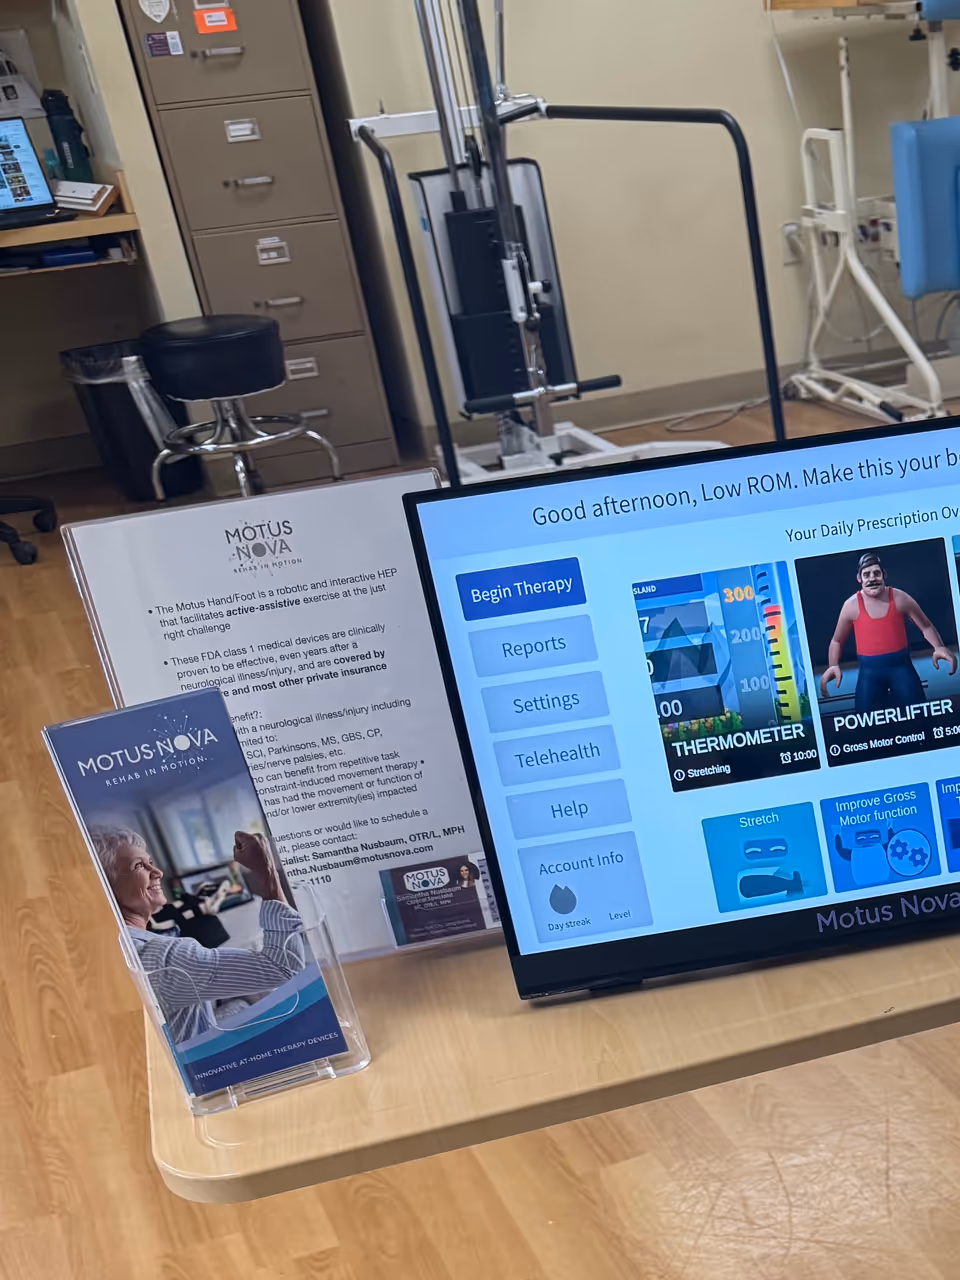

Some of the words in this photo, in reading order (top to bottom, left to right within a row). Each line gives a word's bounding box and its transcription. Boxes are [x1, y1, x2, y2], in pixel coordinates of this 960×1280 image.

[532, 500, 587, 526] Good
[592, 487, 697, 517] afternoon,
[701, 481, 742, 501] Low
[747, 471, 798, 495] ROM.
[803, 463, 854, 487] Make
[857, 457, 894, 480] this
[898, 452, 941, 478] your
[225, 520, 293, 545] MOTUS
[785, 526, 817, 542] Your
[821, 519, 854, 538] Daily
[857, 507, 939, 533] Prescription
[235, 539, 292, 561] NOVA
[233, 565, 258, 574] REHAB
[272, 558, 303, 567] MOTION
[175, 600, 205, 612] Motus
[206, 591, 256, 606] Hand/Foot
[276, 583, 308, 595] robotic
[329, 573, 376, 586] interactive
[376, 567, 397, 579] HEP
[471, 585, 512, 603] Begin
[514, 577, 573, 596] Therapy
[722, 585, 755, 604] 300
[159, 617, 178, 627] that
[179, 610, 224, 624] facilitates
[226, 598, 300, 617] active-assistive
[302, 591, 340, 604] exercise
[369, 583, 386, 595] just
[163, 629, 185, 641] right
[186, 622, 231, 636] challenge
[731, 624, 762, 645] 200
[169, 655, 199, 666] These
[200, 649, 222, 661] FDA
[223, 647, 247, 657] class
[249, 644, 254, 652] 1
[257, 637, 293, 651] medical
[294, 633, 330, 645] devices
[347, 623, 385, 636] clinically
[502, 636, 566, 658] Reports
[176, 667, 209, 680] proven
[235, 656, 277, 668] effective,
[279, 651, 301, 661] even
[302, 647, 328, 659] years
[329, 643, 349, 652] after
[180, 674, 236, 692] neurological
[237, 666, 296, 681] illness/injury,
[333, 650, 372, 665] covered
[372, 649, 385, 659] by
[251, 680, 277, 692] most
[278, 677, 304, 687] other
[305, 670, 339, 685] private
[340, 663, 387, 676] insurance
[740, 674, 770, 694] 100
[258, 714, 313, 731] neurological
[314, 706, 369, 721] illness/injury
[370, 698, 411, 711] including
[513, 693, 580, 714] Settings
[833, 698, 954, 733] POWERLIFTER
[248, 748, 266, 759] SCI,
[267, 741, 320, 756] Parkinsons,
[320, 735, 339, 746] MS,
[341, 731, 365, 742] GBS,
[366, 727, 383, 738] CP,
[672, 722, 806, 758] THERMOMETER
[842, 739, 867, 754] Gross
[869, 734, 893, 750] Motor
[894, 731, 926, 748] Control
[77, 743, 154, 777] MOTUS
[283, 765, 315, 778] benefit
[316, 762, 337, 772] from
[338, 755, 379, 768] repetitive
[380, 750, 400, 760] task
[292, 752, 327, 765] palsies,
[328, 748, 345, 757] etc.
[514, 743, 601, 768] Telehealth
[792, 748, 818, 762] 10:00
[105, 772, 141, 787] REHAB
[144, 767, 157, 777] IN
[161, 755, 204, 773] MOTION
[337, 765, 384, 780] movement
[384, 760, 417, 772] therapy
[687, 763, 732, 780] Stretching
[317, 781, 364, 797] movement
[376, 773, 413, 785] function
[291, 803, 316, 814] lower
[317, 791, 375, 808] extremity(ies)
[376, 783, 417, 798] impacted
[551, 800, 589, 819] Help
[835, 794, 881, 814] Improve
[883, 788, 917, 805] Gross
[324, 820, 352, 833] would
[352, 819, 368, 828] like
[381, 809, 420, 823] schedule
[739, 810, 780, 829] Stretch
[839, 812, 872, 828] Motor
[873, 803, 918, 823] function
[291, 840, 321, 853] please
[321, 832, 358, 845] contact:
[311, 845, 359, 860] Samantha
[360, 837, 407, 851] Nusbaum,
[408, 830, 441, 842] OTR/L,
[442, 825, 465, 836] MPH
[406, 868, 446, 883] MOTUS
[539, 856, 595, 876] Account
[597, 851, 624, 866] Info
[412, 878, 444, 890] NOVA
[548, 922, 564, 932] Day
[565, 917, 591, 929] streak
[609, 910, 632, 921] Level
[816, 903, 893, 933] Motus
[194, 1061, 238, 1081] INNOVATIVE
[239, 1050, 272, 1066] AT-HOME
[273, 1041, 306, 1056] THERAPY
[307, 1031, 339, 1045] DEVICES
